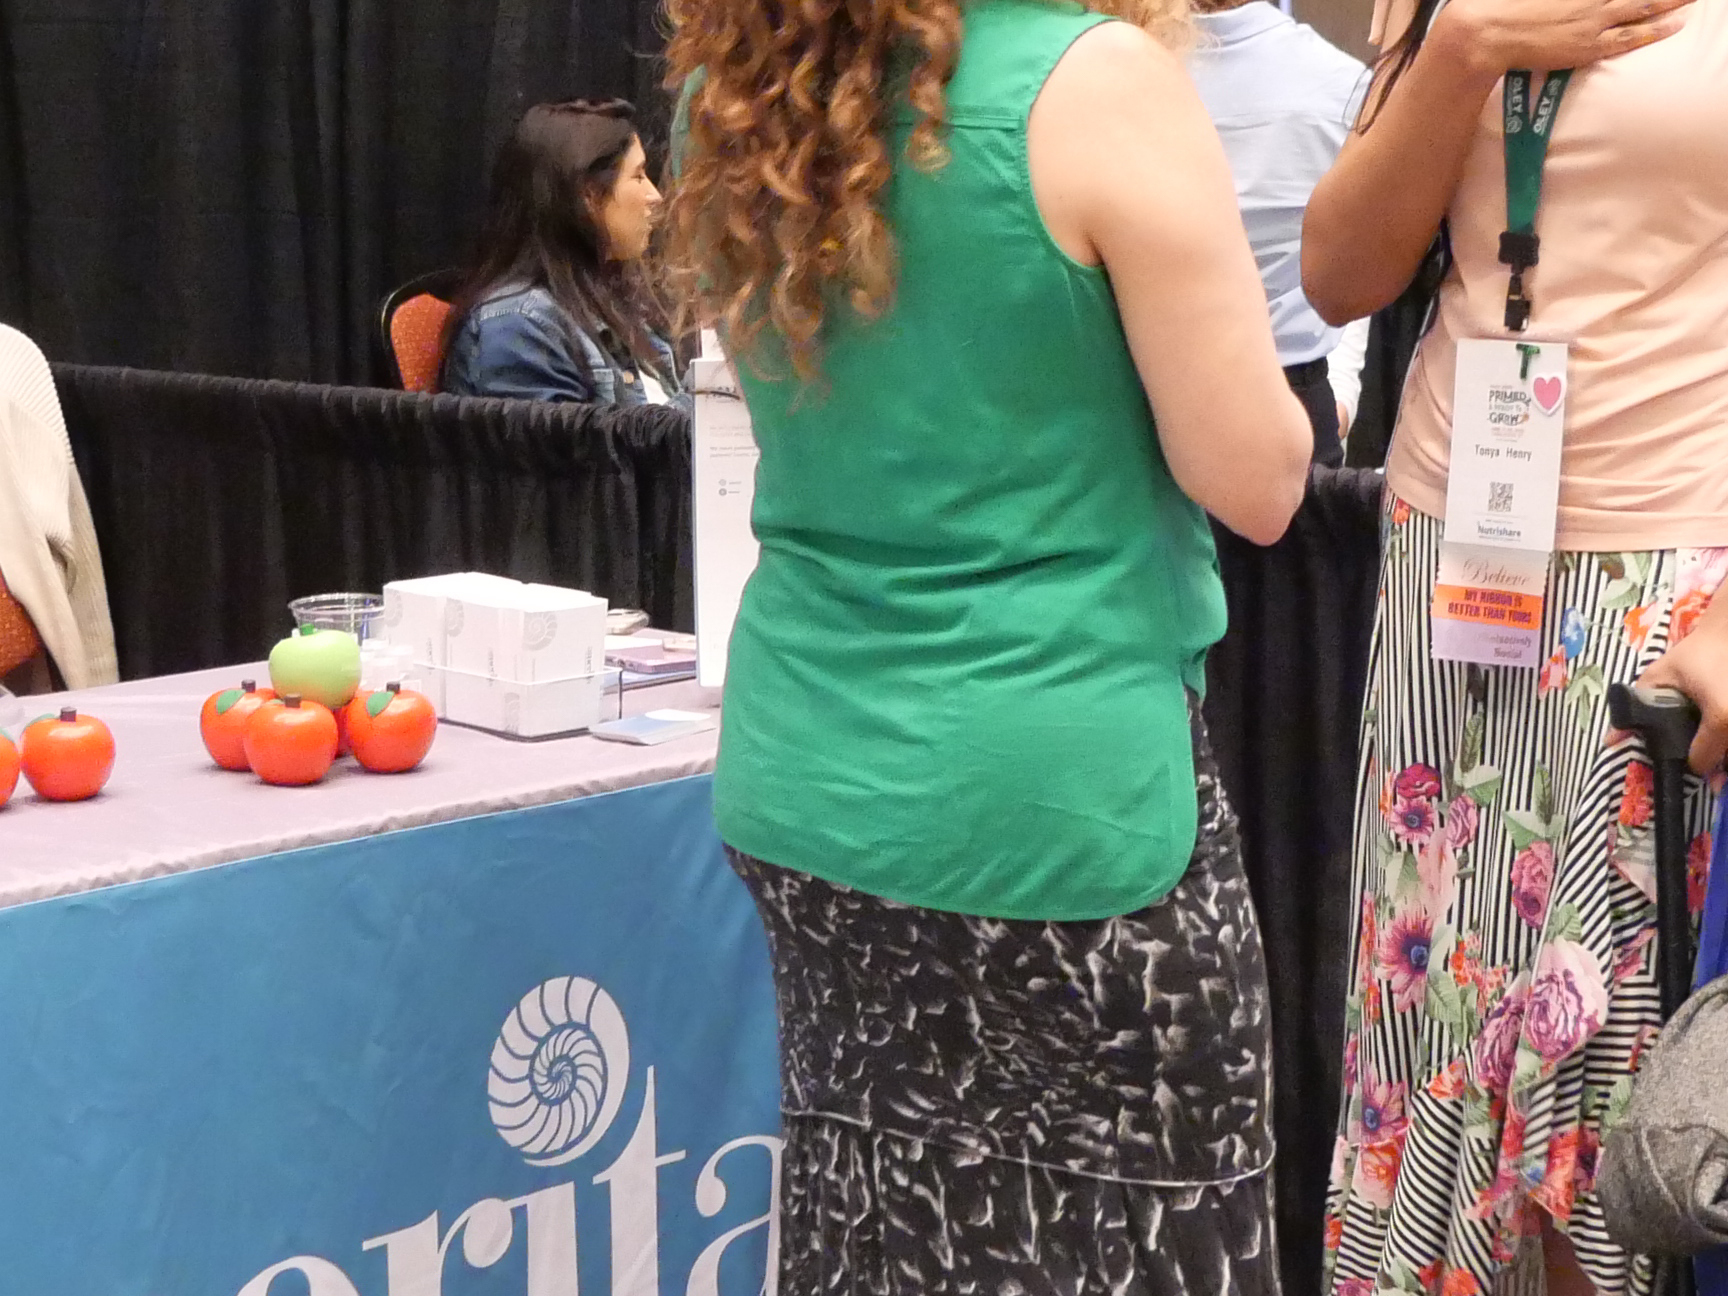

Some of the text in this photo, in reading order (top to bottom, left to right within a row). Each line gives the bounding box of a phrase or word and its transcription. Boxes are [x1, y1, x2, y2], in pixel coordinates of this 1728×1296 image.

[1512, 76, 1524, 113] OLEY
[1533, 95, 1551, 134] OLEY
[1475, 444, 1532, 462] Tonya Henry
[1477, 524, 1522, 537] Nutrishare
